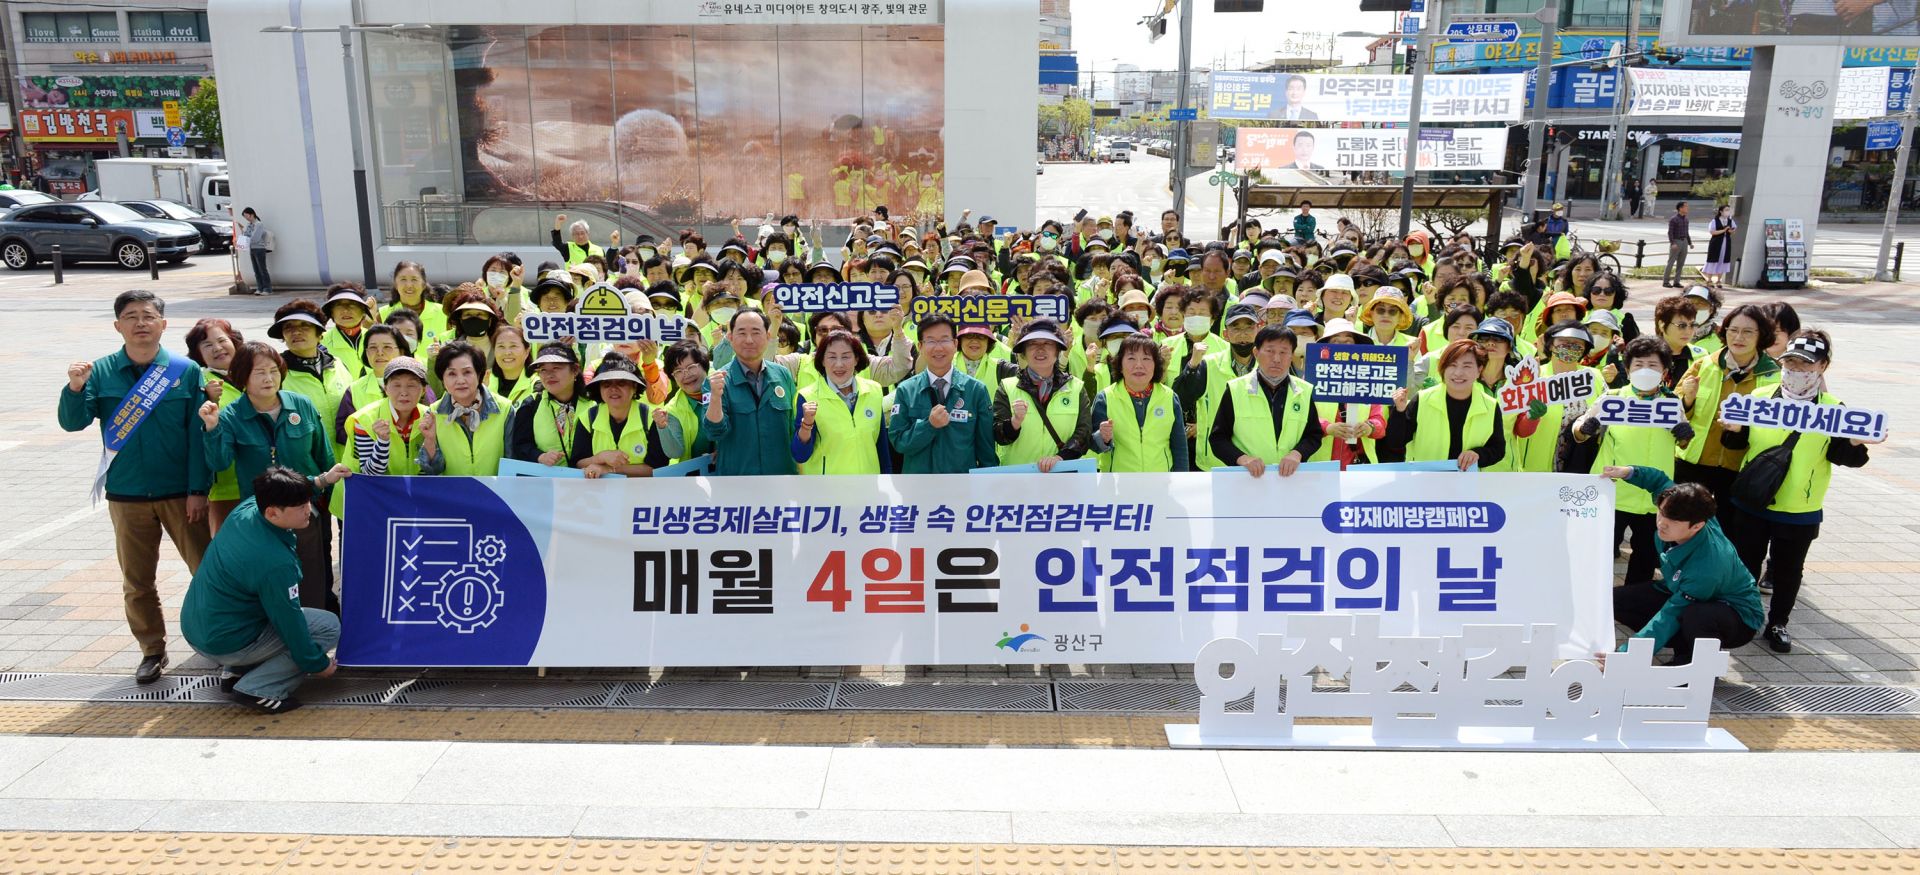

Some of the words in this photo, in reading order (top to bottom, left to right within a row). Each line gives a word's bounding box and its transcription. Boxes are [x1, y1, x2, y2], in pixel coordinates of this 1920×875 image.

[724, 4, 763, 14] 유네스코
[766, 4, 815, 14] 미디어아트
[819, 4, 857, 14] 창의도시
[861, 4, 883, 15] 광주,
[886, 4, 905, 14] 빛의
[908, 4, 927, 14] 관문
[170, 27, 193, 36] dvd
[1802, 105, 1823, 118] 광산
[42, 112, 109, 136] 김밥천국
[777, 284, 897, 312] 안전신고는
[913, 296, 1067, 323] 안전신문고로!
[524, 314, 653, 341] 안전점검의
[658, 313, 684, 341] 날
[1333, 351, 1350, 362] 생활
[1352, 352, 1359, 362] 속
[1361, 352, 1397, 363] 위해요소!
[1315, 363, 1398, 381] 안전신문고로
[1314, 381, 1397, 399] 신고해주세요
[1501, 372, 1594, 411] 화재예방
[1600, 400, 1679, 424] 오늘도
[1723, 396, 1884, 438] 실천하세요!
[632, 506, 848, 537] 민생경제살리기,
[859, 506, 919, 534] 생활
[927, 506, 955, 533] 속
[965, 504, 1153, 533] 안전점검부터!
[1338, 506, 1489, 528] 화재예방캠페인
[1581, 507, 1597, 518] 광산
[633, 548, 774, 615] 매월
[806, 547, 1001, 614] 4일은
[1035, 546, 1401, 612] 안전점검의
[1437, 546, 1503, 612] 날
[1054, 634, 1103, 652] 광산구
